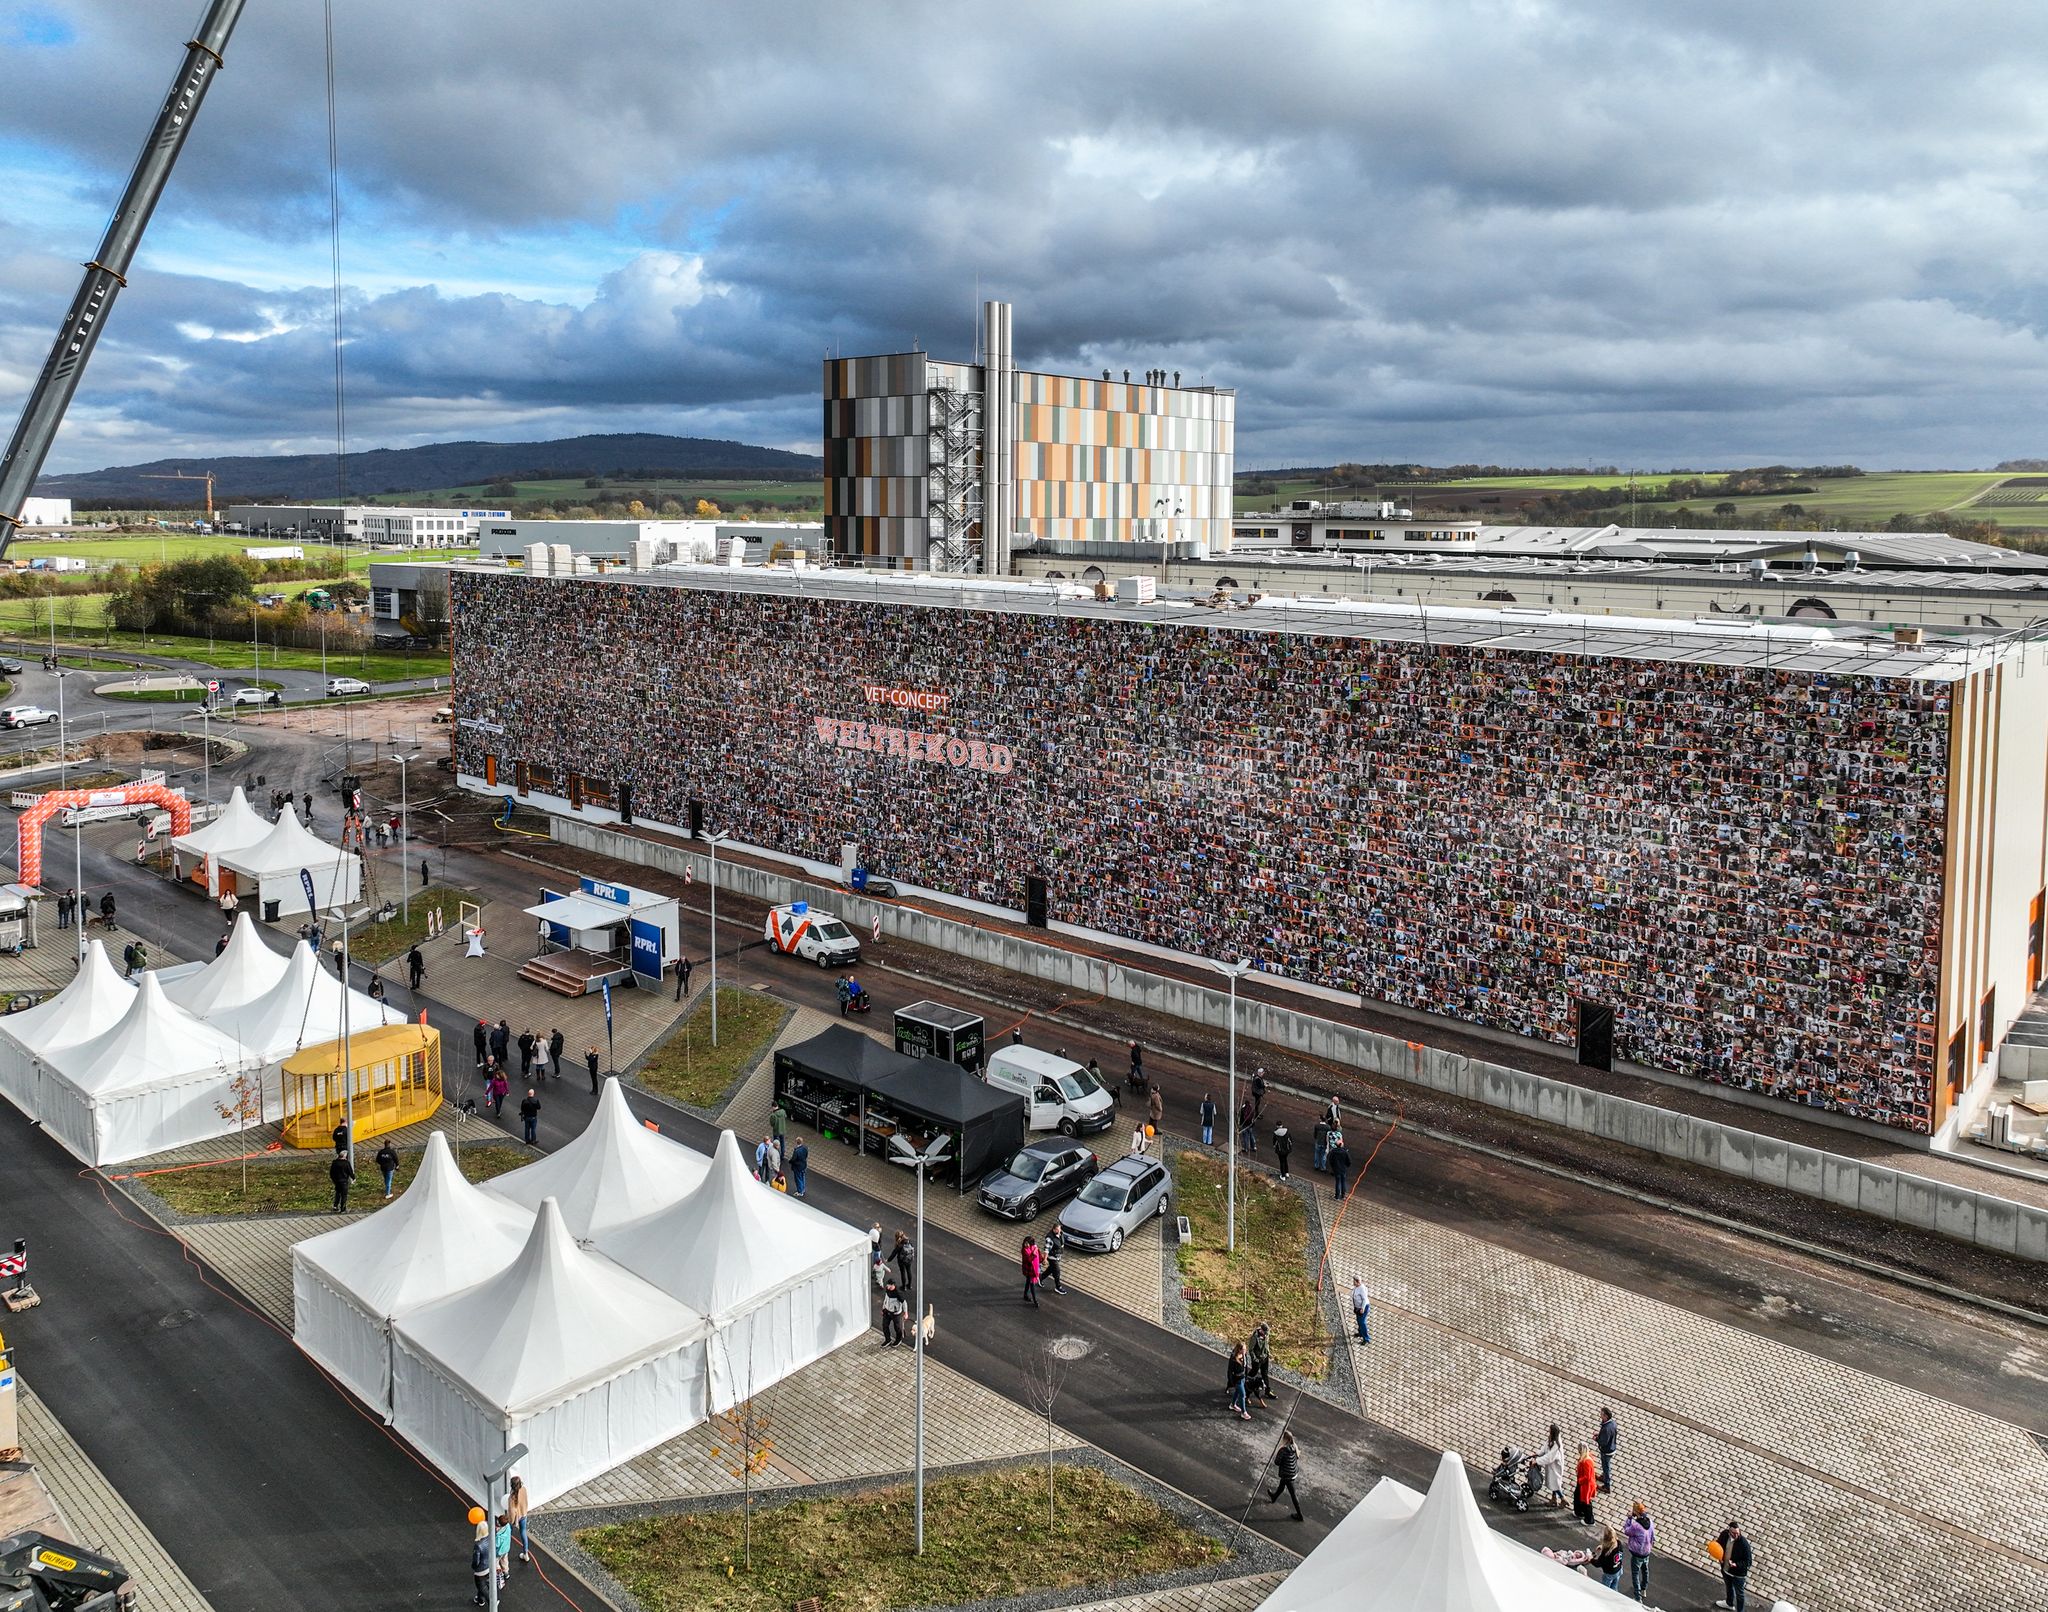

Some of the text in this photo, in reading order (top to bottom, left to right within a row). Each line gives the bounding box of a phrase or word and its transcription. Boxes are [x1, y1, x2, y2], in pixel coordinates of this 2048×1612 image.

[173, 64, 205, 126] STEIL
[70, 286, 106, 353] STEIL
[864, 685, 950, 711] VET-CONCEPT
[814, 716, 1013, 775] WELTREKORD
[593, 882, 617, 900] RPR1.
[634, 936, 658, 954] RPR1.
[42, 1552, 74, 1569] PALFINGER
